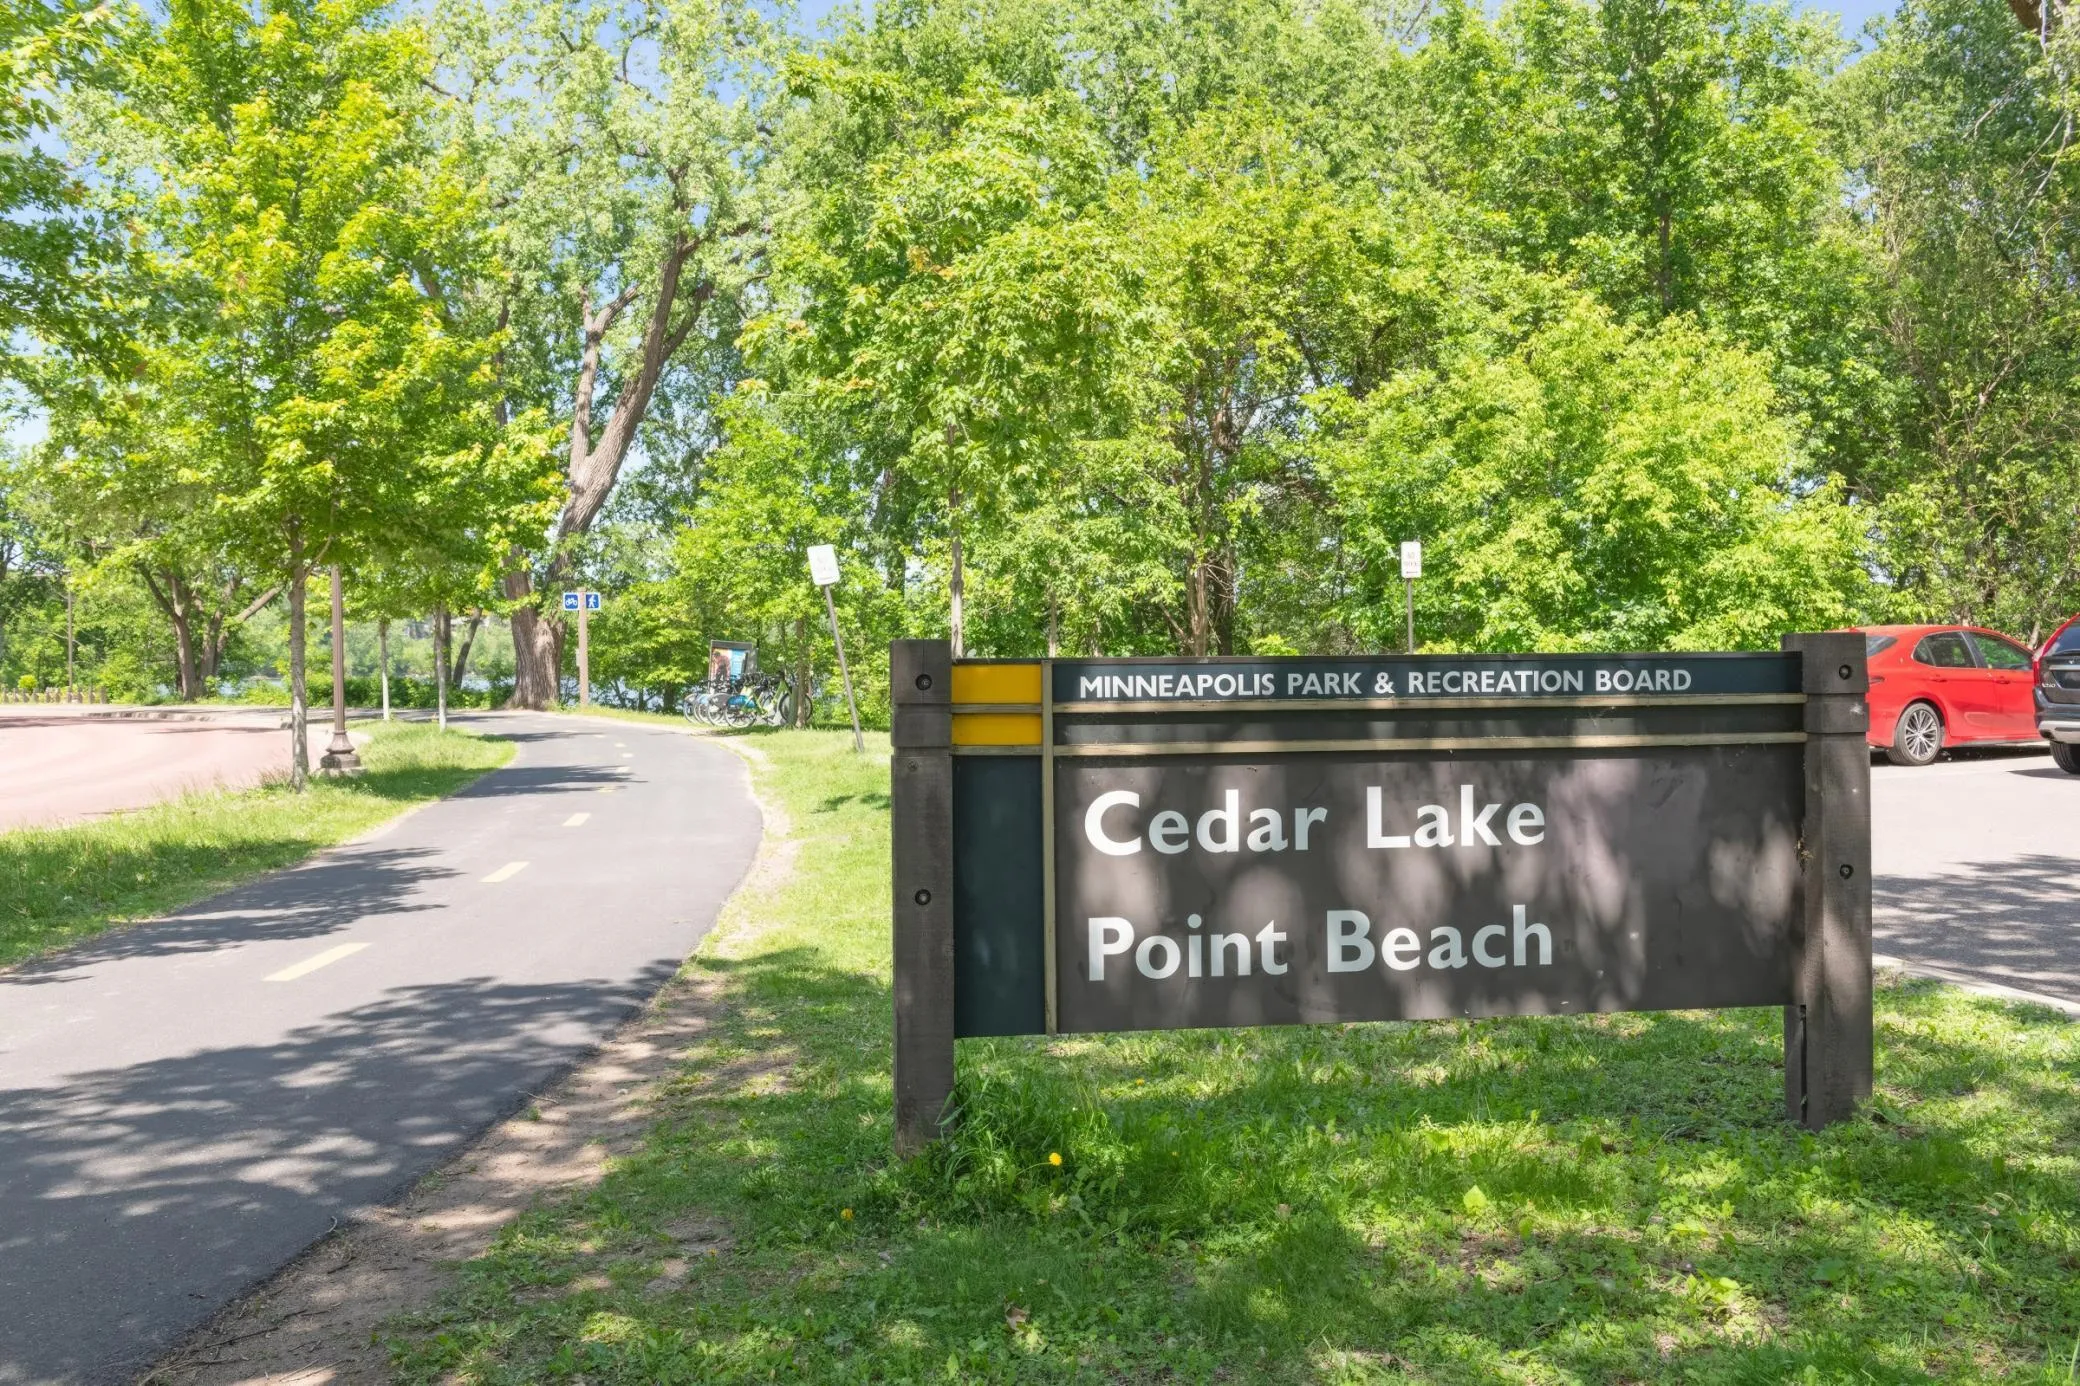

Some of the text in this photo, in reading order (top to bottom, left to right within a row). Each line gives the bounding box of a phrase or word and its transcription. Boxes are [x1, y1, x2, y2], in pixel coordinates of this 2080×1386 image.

[1080, 669, 1692, 698] MINNEAPOLIS PARK & RECREATION BOARD
[1084, 785, 1546, 856] Cedar Lake
[1087, 905, 1553, 982] Point Beach
